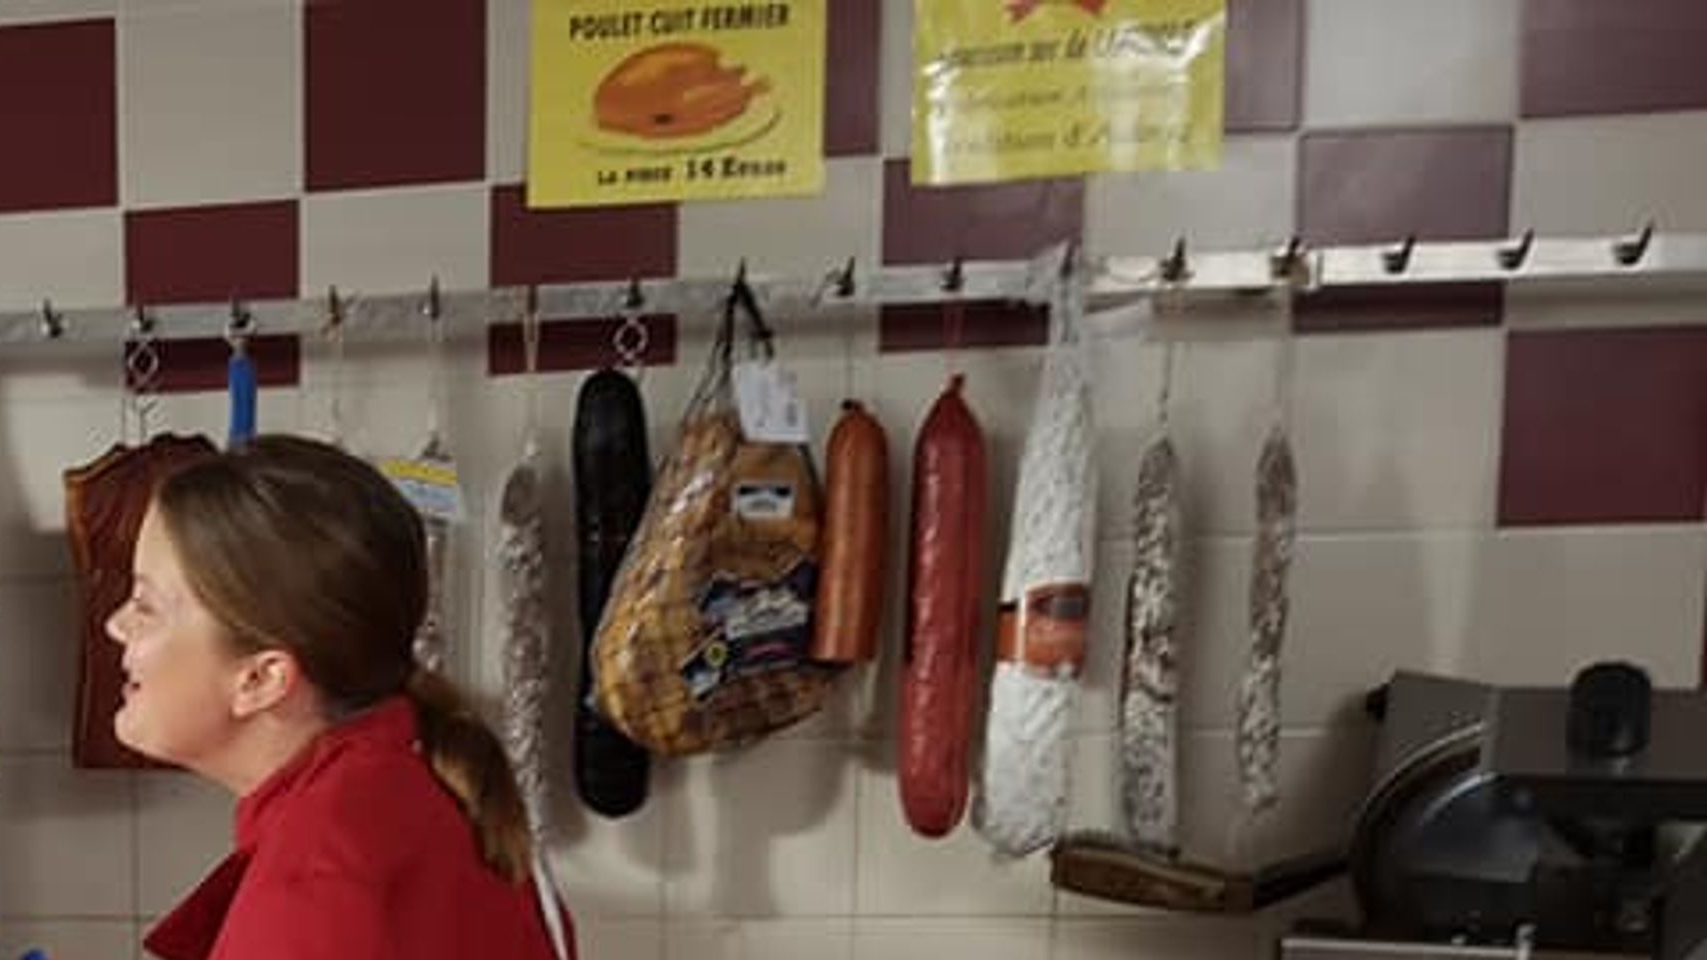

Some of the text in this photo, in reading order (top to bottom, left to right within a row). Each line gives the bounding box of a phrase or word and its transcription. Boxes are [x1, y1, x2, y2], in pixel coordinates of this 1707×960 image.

[569, 3, 789, 41] POULET CUIT FERMIER
